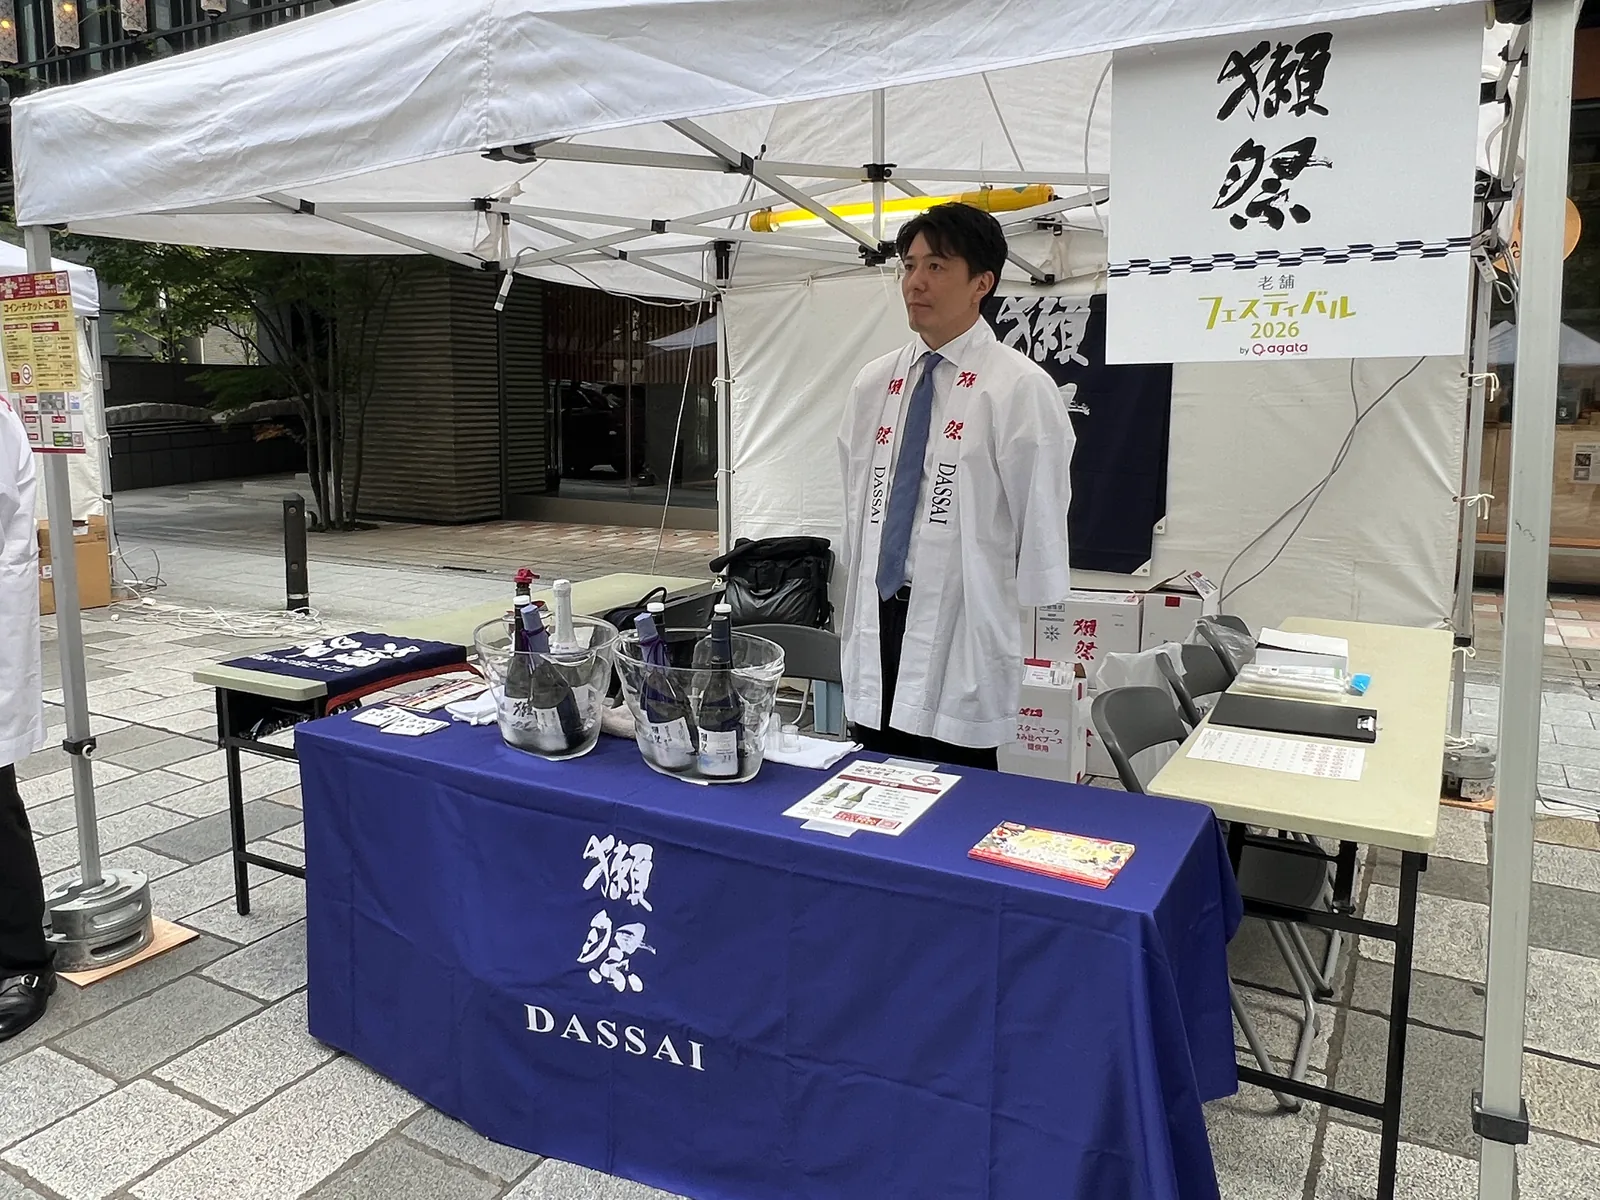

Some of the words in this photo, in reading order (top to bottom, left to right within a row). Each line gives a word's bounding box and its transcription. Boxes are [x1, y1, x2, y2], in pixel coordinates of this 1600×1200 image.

[1211, 31, 1334, 231] 獺祭
[1197, 290, 1357, 331] フェスティバル
[1257, 274, 1295, 291] 老舗
[996, 297, 1091, 415] 獺
[1239, 346, 1250, 356] by
[1250, 321, 1300, 339] 2026
[870, 466, 887, 524] DASSAI
[928, 462, 957, 525] DASSAI
[1017, 724, 1061, 736] スターマーク
[576, 834, 657, 993] 獺祭
[523, 1003, 706, 1072] DASSAI
